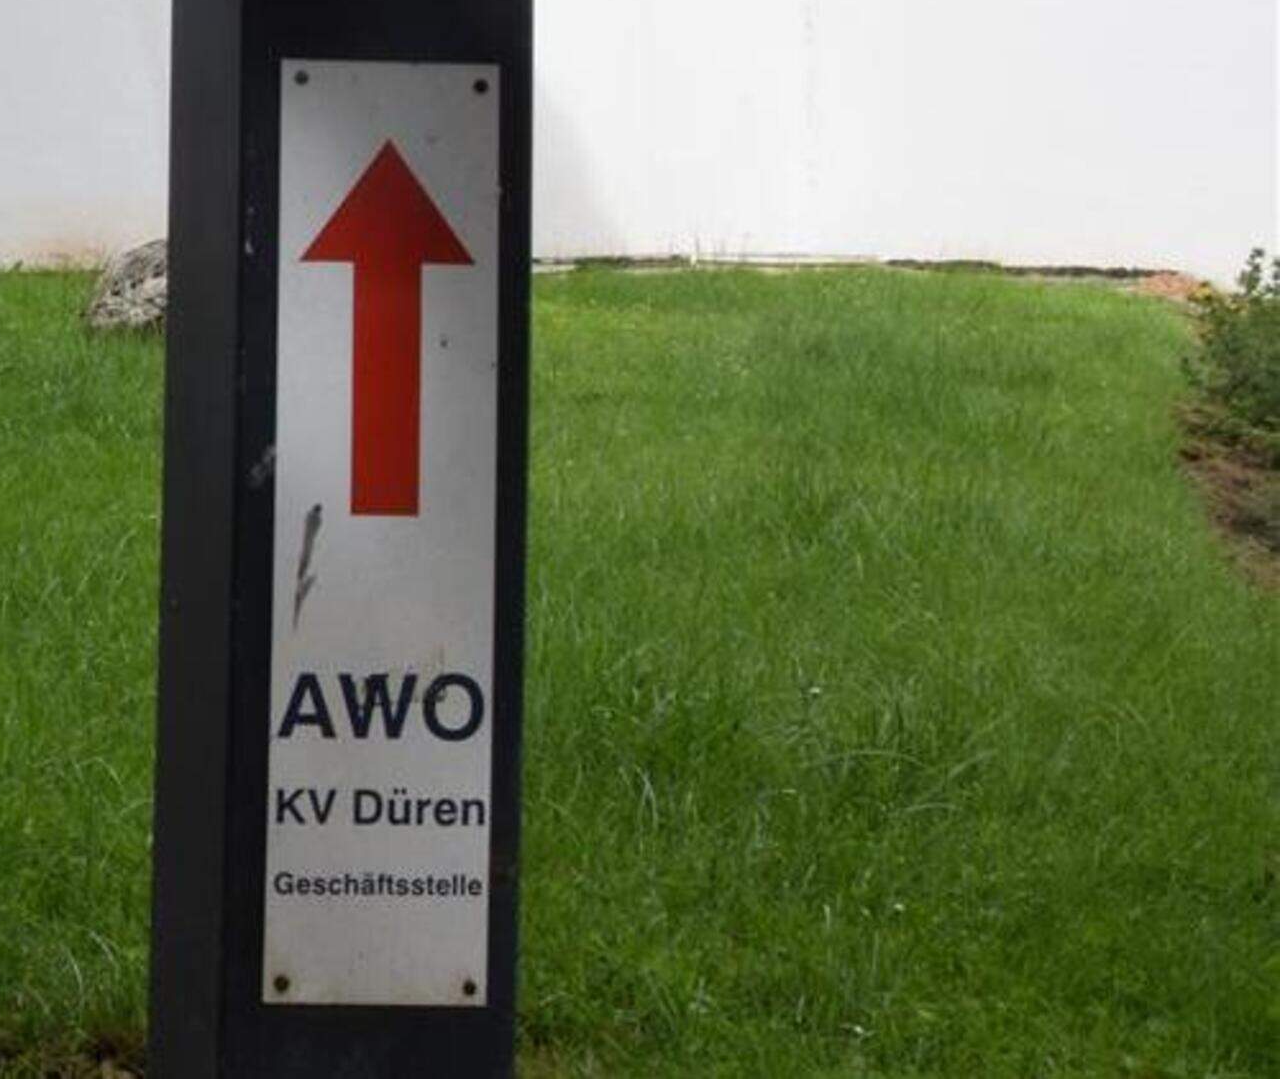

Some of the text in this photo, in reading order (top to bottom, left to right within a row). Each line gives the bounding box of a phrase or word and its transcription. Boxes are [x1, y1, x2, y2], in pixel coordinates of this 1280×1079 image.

[277, 671, 485, 742] AWO
[275, 788, 486, 826] KV Düren
[273, 871, 484, 897] Geschäftsstelle
